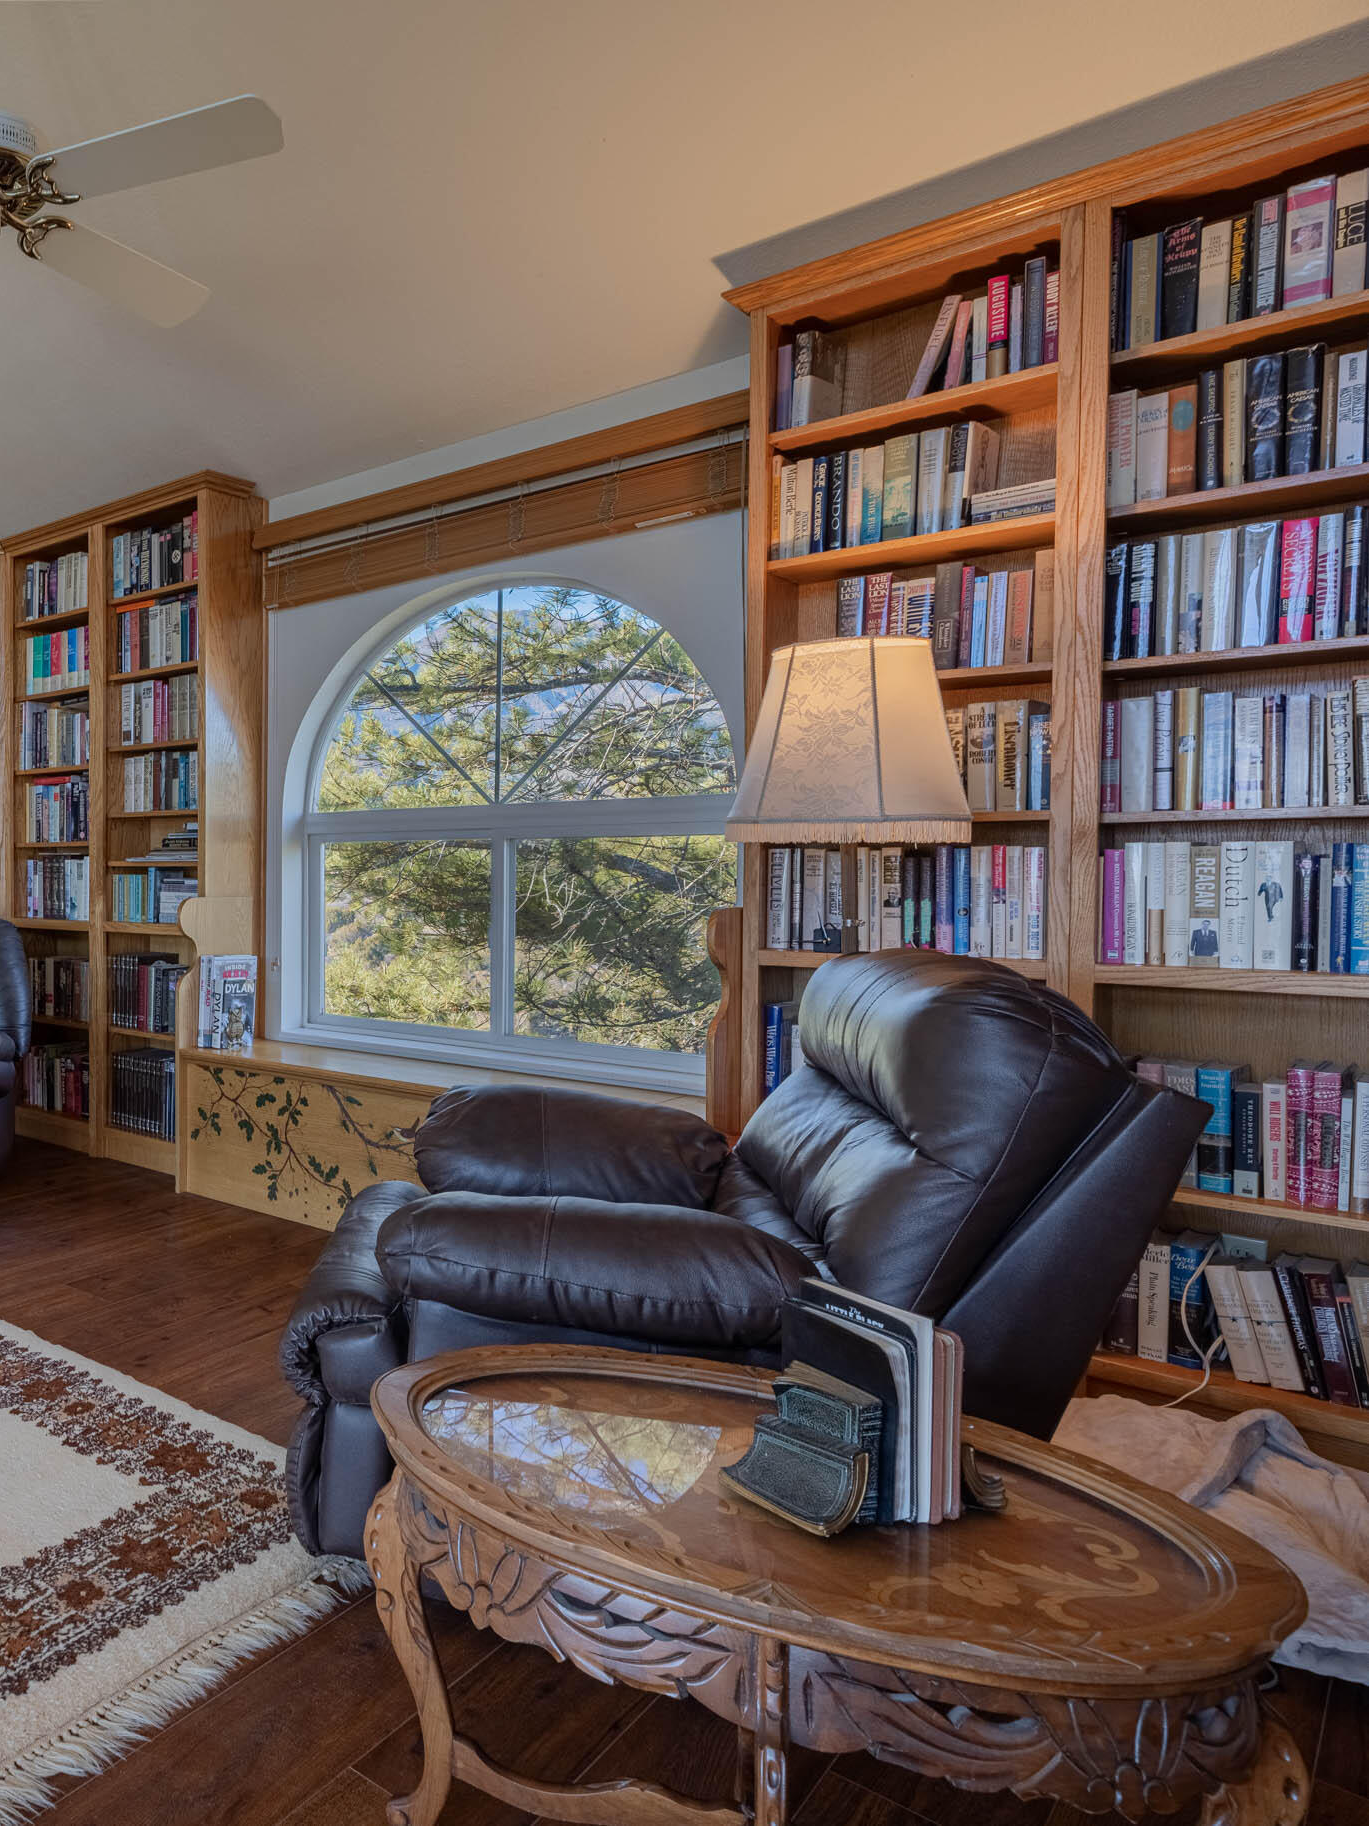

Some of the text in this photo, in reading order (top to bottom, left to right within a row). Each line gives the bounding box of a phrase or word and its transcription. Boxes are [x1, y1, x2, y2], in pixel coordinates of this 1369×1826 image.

[1347, 202, 1366, 246] LUCE
[1045, 273, 1059, 303] WOODY
[929, 301, 953, 350] INFIDEL
[991, 281, 1006, 339] AUGUSTINE
[1286, 388, 1320, 400] AMERICAN
[785, 467, 797, 516] Milton Berle
[831, 455, 842, 530] BRANDO
[871, 576, 888, 584] THE
[1282, 531, 1300, 591] SECRETS
[841, 592, 861, 600] LION
[869, 583, 888, 591] LAST
[869, 589, 888, 597] LION
[1003, 721, 1019, 790] Eisenhower
[1106, 732, 1114, 757] PATTON
[771, 853, 784, 911] ELVIS
[1176, 853, 1188, 896] REAGAN
[1194, 857, 1217, 909] REAGAN
[1224, 847, 1249, 908] Dutch
[1030, 914, 1040, 929] BOB
[1353, 880, 1362, 939] THE INSIDE STORY
[1030, 931, 1040, 951] HOPE
[1127, 926, 1136, 951] REAGAN
[225, 982, 255, 994] DYLAN
[212, 992, 221, 1034] DYLAN
[1246, 1099, 1254, 1164] THEODORE REX
[1269, 1100, 1281, 1142] WILL ROGERS
[1171, 1254, 1196, 1263] Dear
[1146, 1272, 1159, 1327] Plain Speaking
[1278, 1273, 1307, 1350] CLARENCE THOMAS
